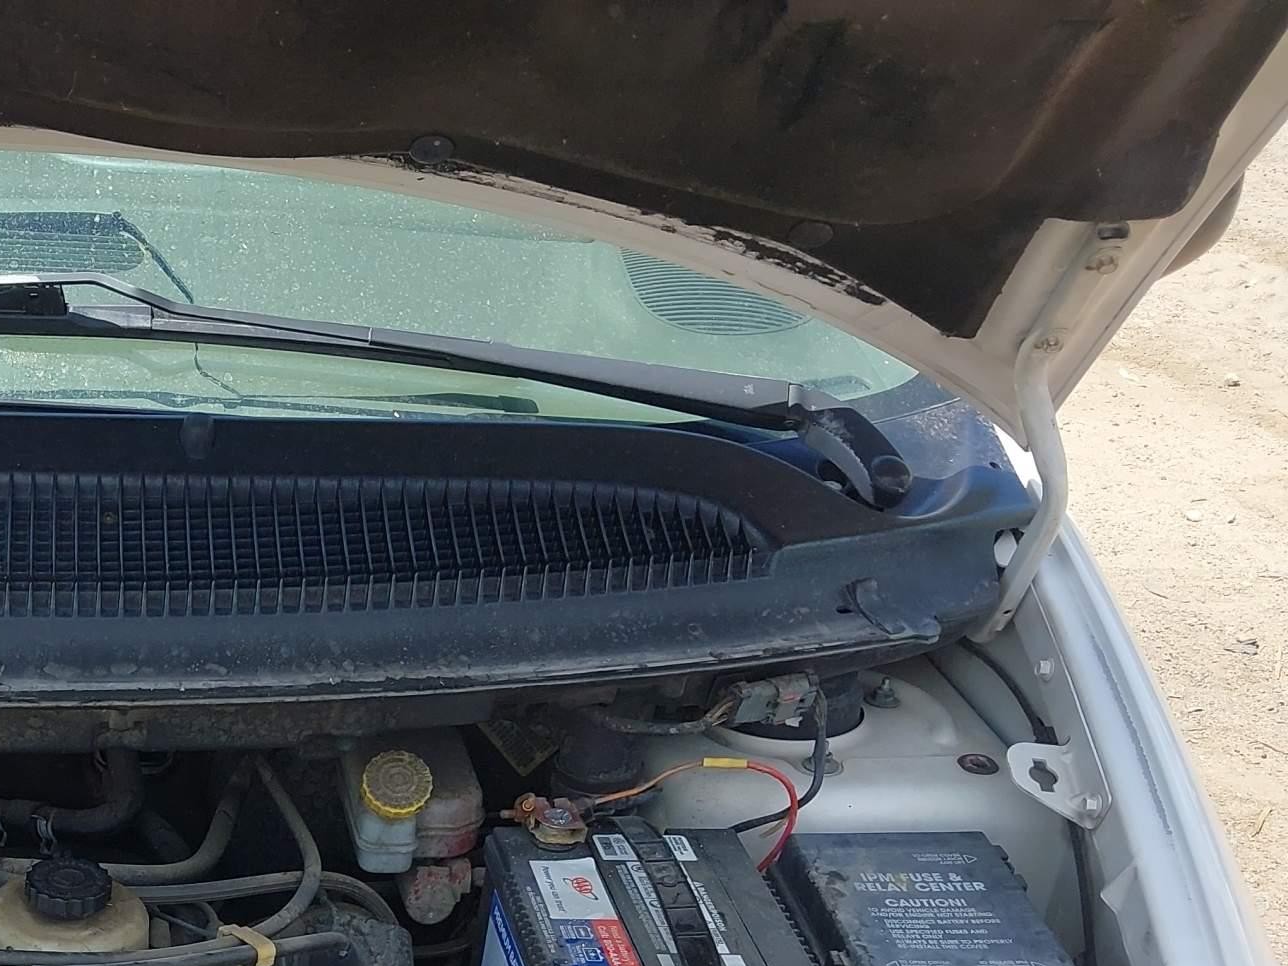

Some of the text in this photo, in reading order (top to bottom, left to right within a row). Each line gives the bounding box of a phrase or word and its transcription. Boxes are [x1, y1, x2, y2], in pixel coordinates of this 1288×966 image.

[860, 873, 963, 882] IPM FUSE &
[853, 882, 987, 892] RELAY CENTER
[884, 898, 968, 907] CAUTION!
[493, 904, 513, 957] PREMIUM
